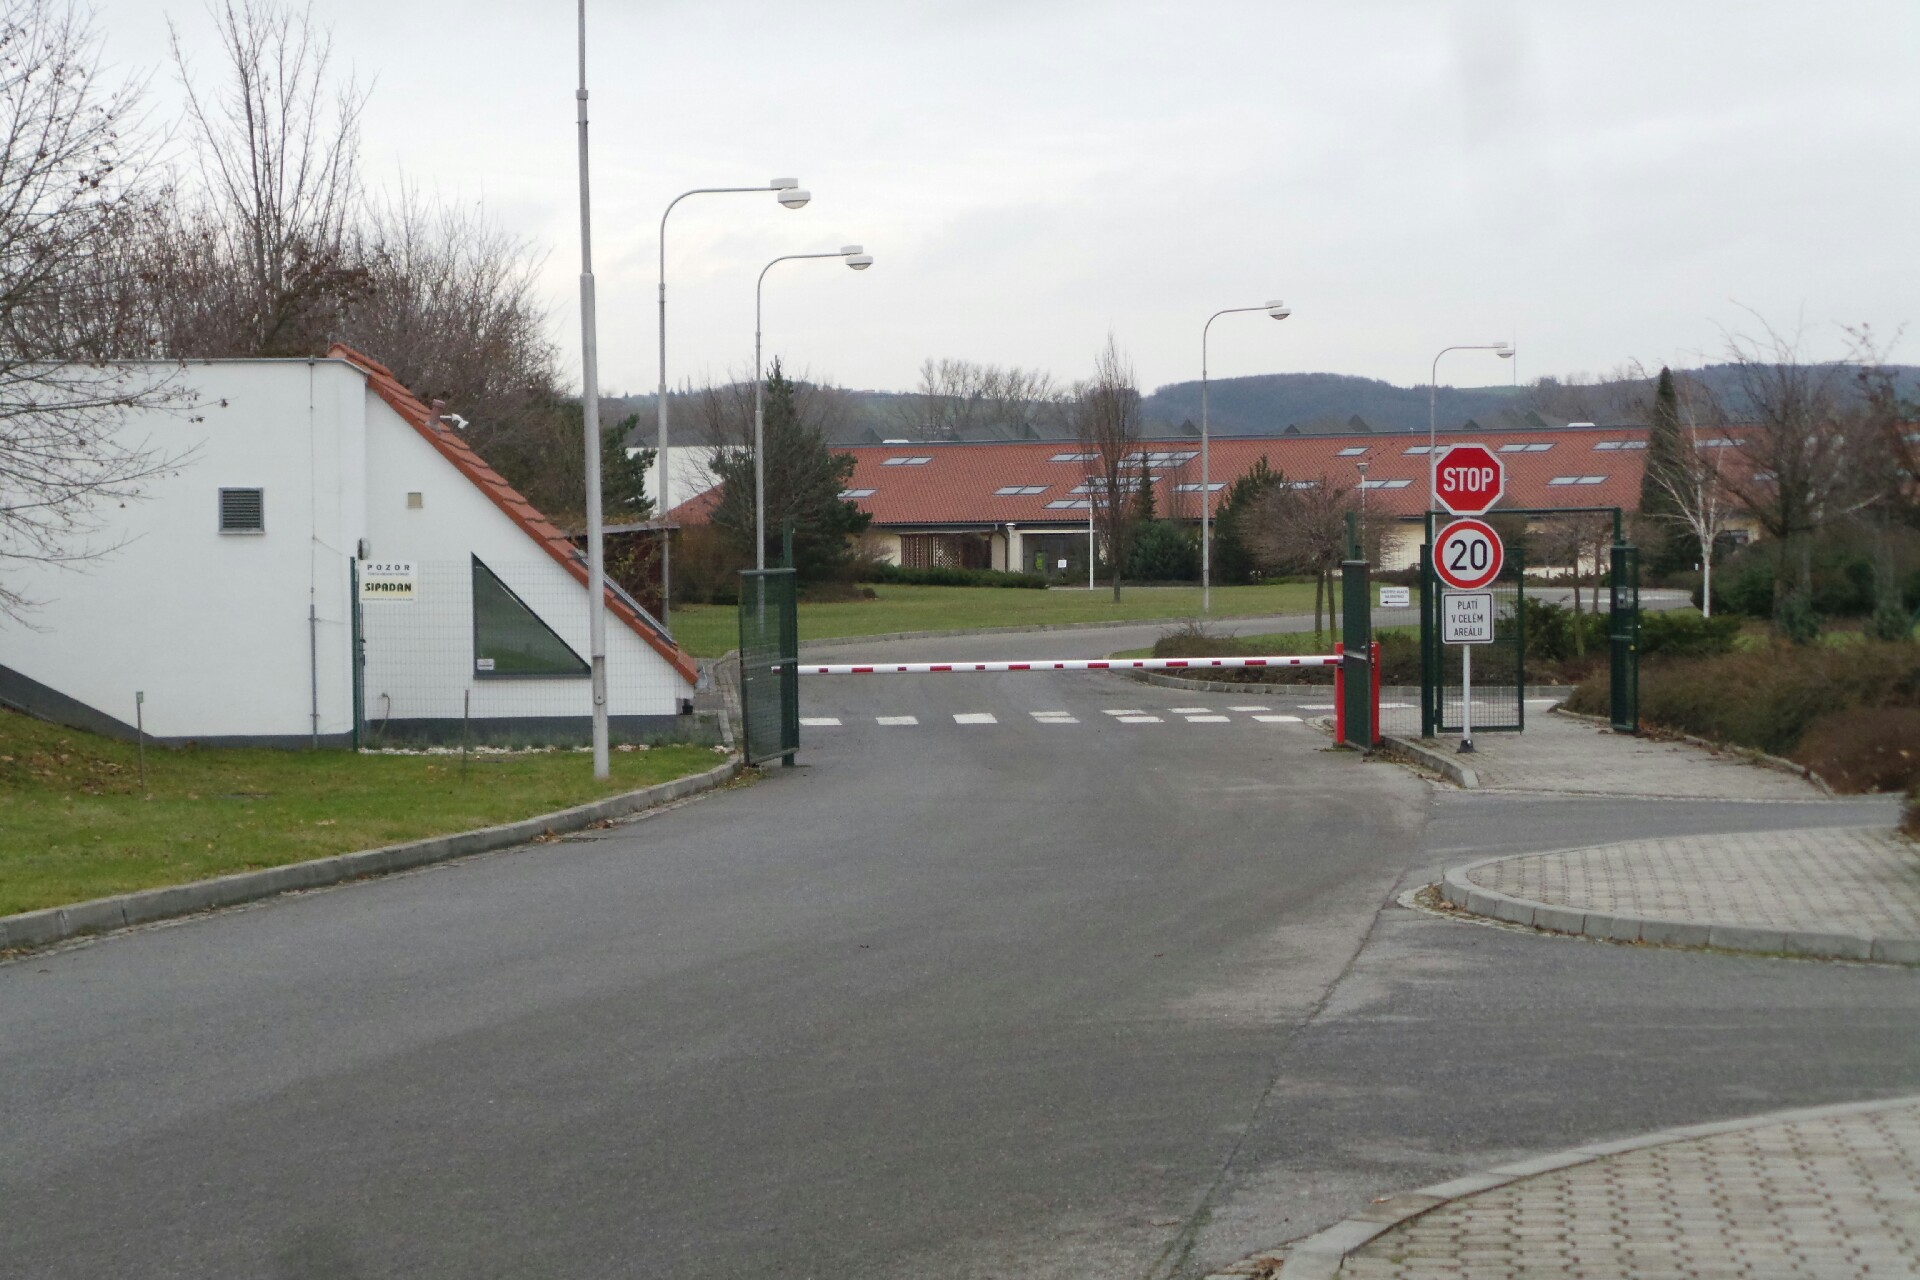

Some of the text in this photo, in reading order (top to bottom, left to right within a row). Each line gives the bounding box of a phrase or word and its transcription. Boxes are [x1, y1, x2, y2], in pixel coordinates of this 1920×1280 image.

[1443, 467, 1494, 492] STOP
[1450, 539, 1487, 571] 20
[365, 582, 412, 592] SIPADAN
[1457, 598, 1478, 610] PLATÍ
[1451, 612, 1484, 623] V CELÉM
[1454, 624, 1483, 636] AREÁLU
